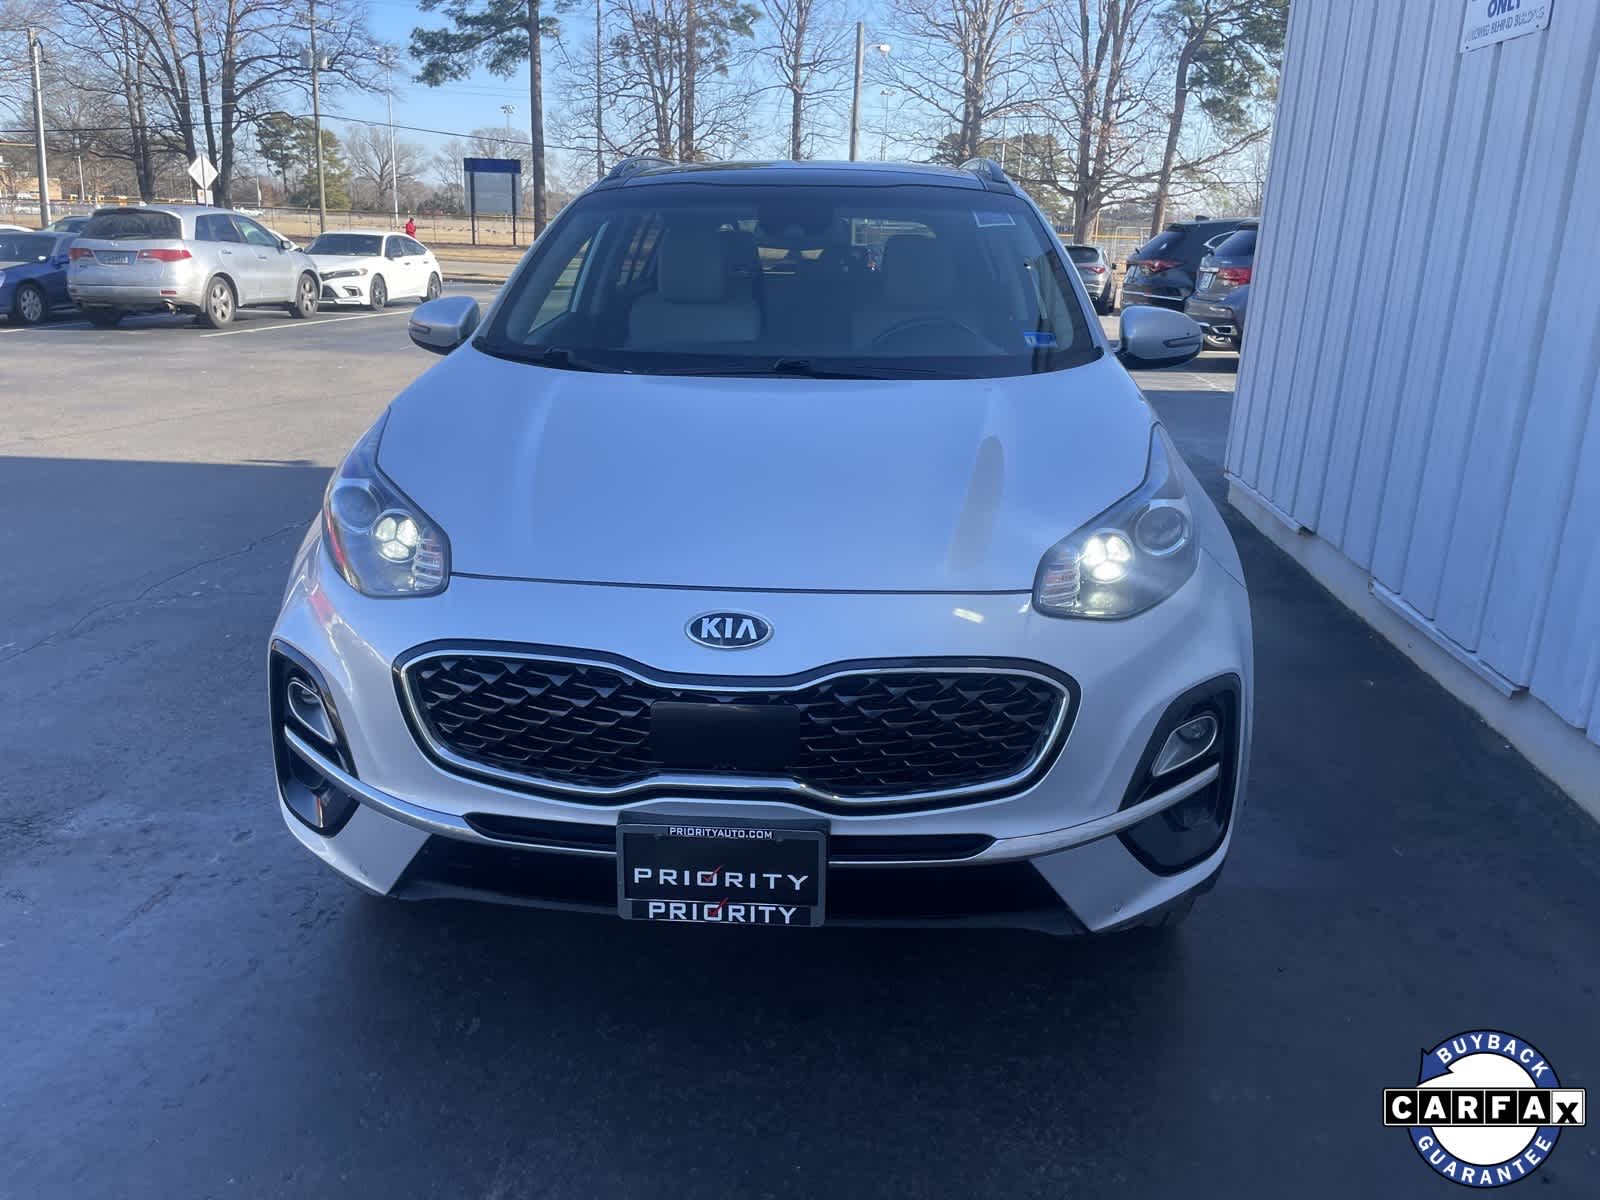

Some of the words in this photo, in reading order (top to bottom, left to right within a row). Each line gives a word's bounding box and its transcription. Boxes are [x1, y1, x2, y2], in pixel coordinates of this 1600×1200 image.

[700, 617, 758, 640] KIA
[669, 826, 773, 840] PRIORITYAUTO.COM
[633, 867, 809, 891] PRIORITY
[648, 901, 798, 925] PRIORITY
